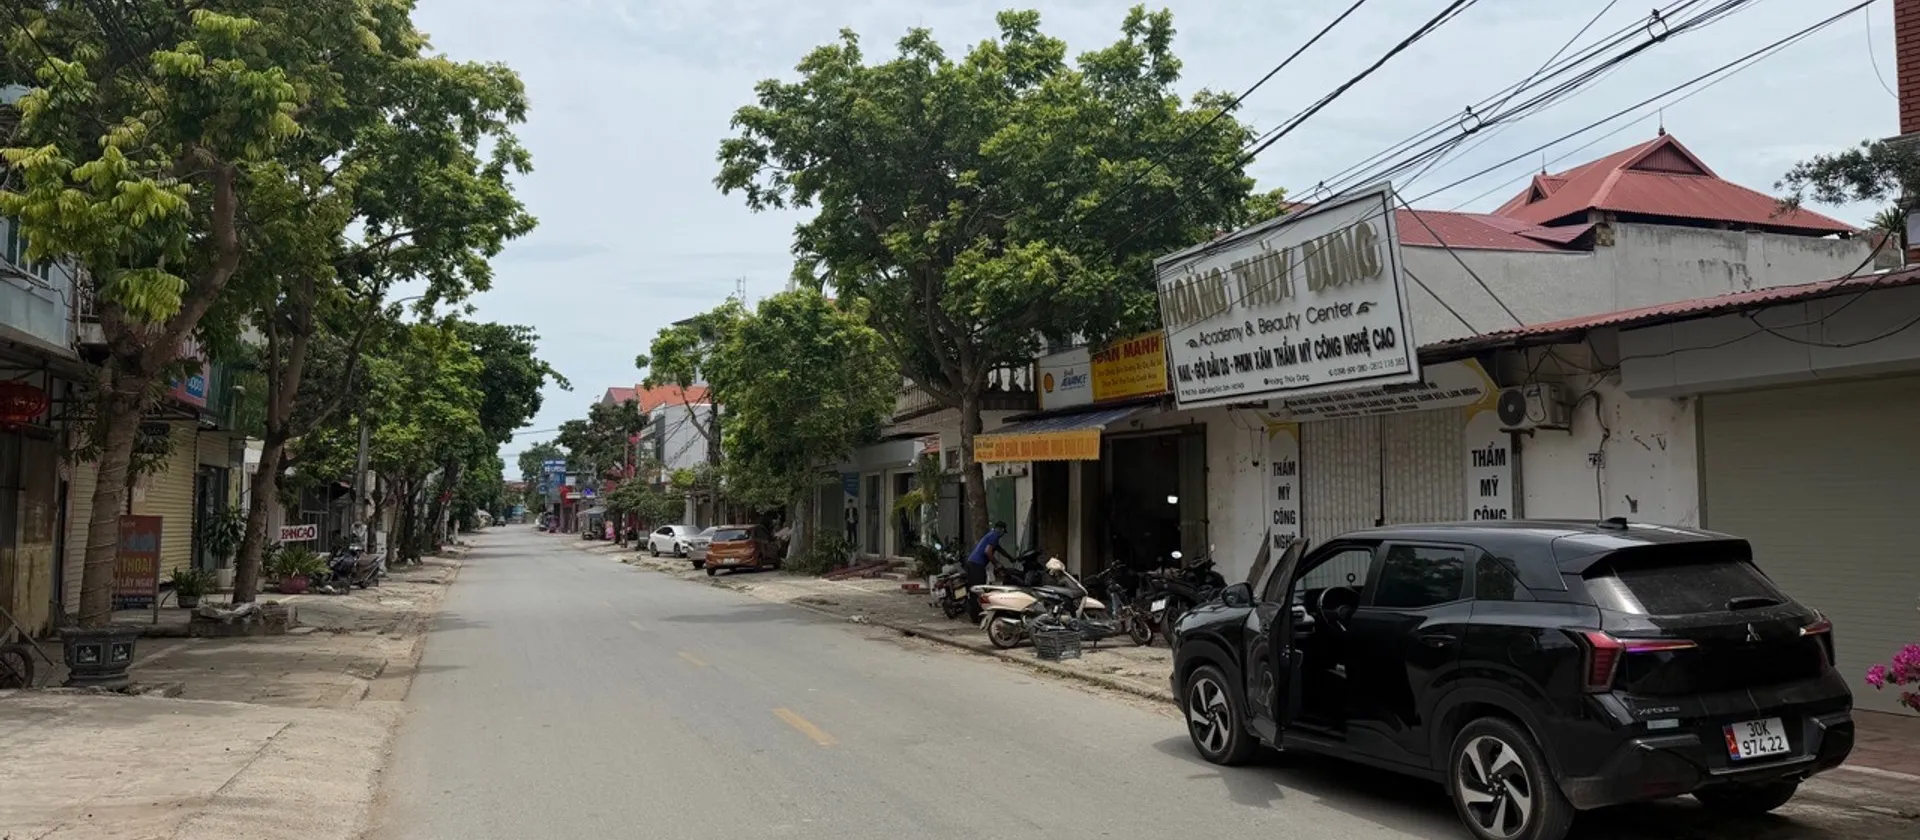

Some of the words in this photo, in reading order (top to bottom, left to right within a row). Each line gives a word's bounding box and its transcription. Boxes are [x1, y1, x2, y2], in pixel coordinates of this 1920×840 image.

[1302, 220, 1384, 293] DUNG
[1199, 325, 1244, 347] Academy
[1245, 321, 1256, 336] &
[1258, 310, 1300, 336] Beauty
[1306, 301, 1352, 325] Center
[1372, 325, 1396, 353] CAO
[1748, 721, 1770, 738] 30K
[1742, 735, 1784, 756] 974.22
